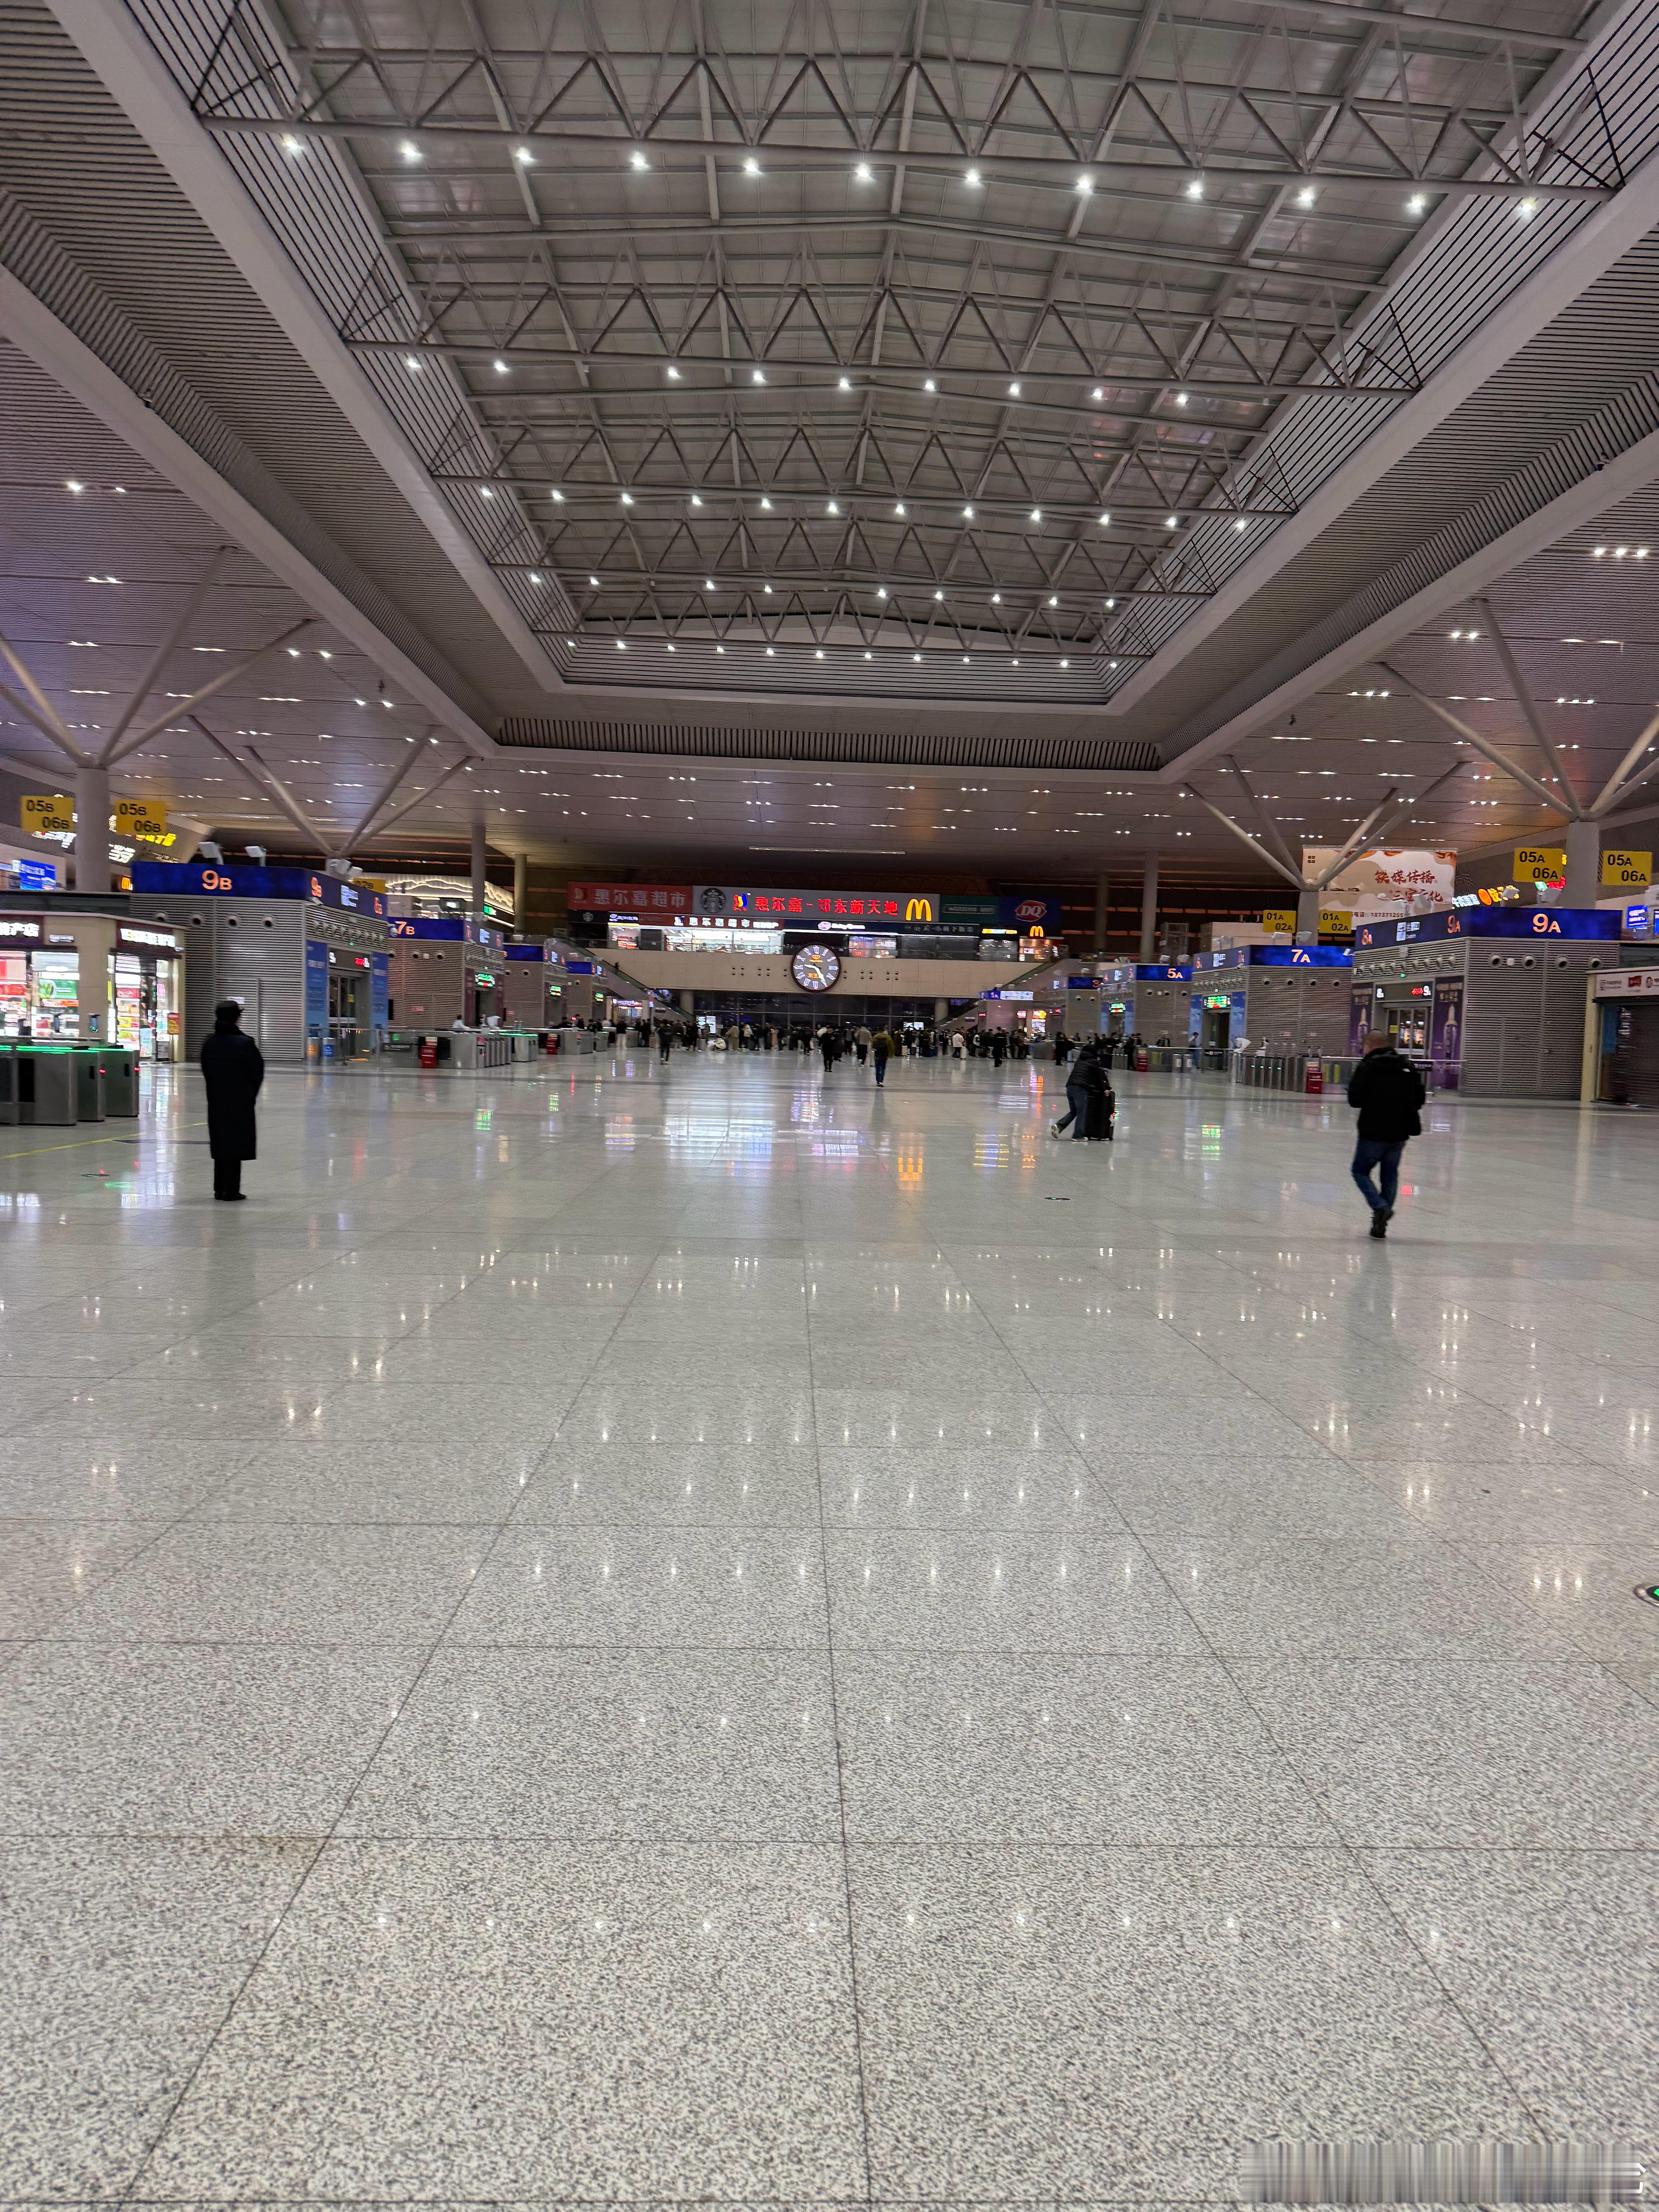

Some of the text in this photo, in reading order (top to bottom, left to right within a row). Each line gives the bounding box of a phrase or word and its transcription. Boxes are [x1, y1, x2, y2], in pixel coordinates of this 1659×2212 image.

[26, 800, 53, 812] 05B
[120, 803, 146, 815] 05B
[42, 817, 69, 829] 06B
[134, 820, 160, 832] 06B
[1519, 851, 1545, 863] 05A
[1607, 854, 1633, 866] 05A
[1532, 867, 1558, 879] 06A
[1621, 870, 1647, 881] 06A
[202, 870, 232, 890] 9B
[1020, 905, 1042, 917] DQ
[395, 921, 415, 935] 7B
[1532, 914, 1561, 933] 9A
[1291, 949, 1311, 963] 7A
[1167, 968, 1183, 979] 5A
